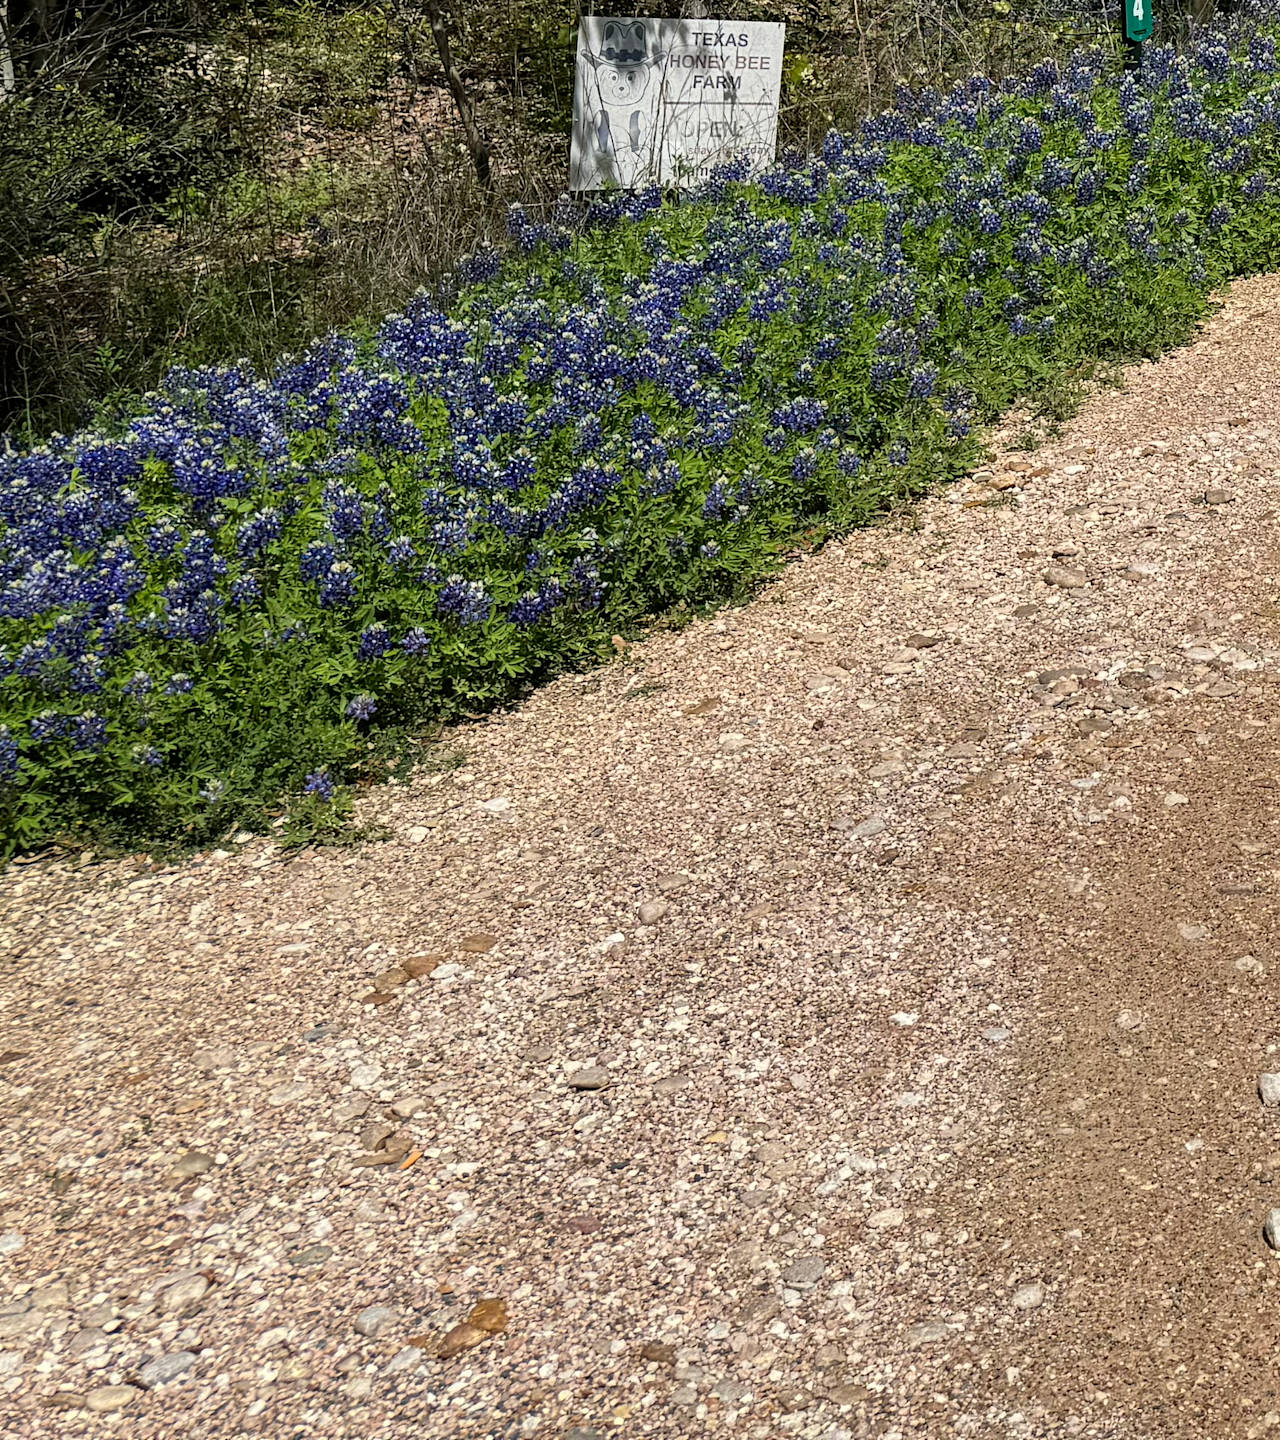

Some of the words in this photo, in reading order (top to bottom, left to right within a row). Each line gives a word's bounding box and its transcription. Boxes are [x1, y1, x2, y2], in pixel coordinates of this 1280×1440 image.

[692, 32, 749, 47] TEXAS
[669, 54, 731, 69] HONEY
[735, 56, 770, 70] BEE
[693, 75, 742, 90] FARM
